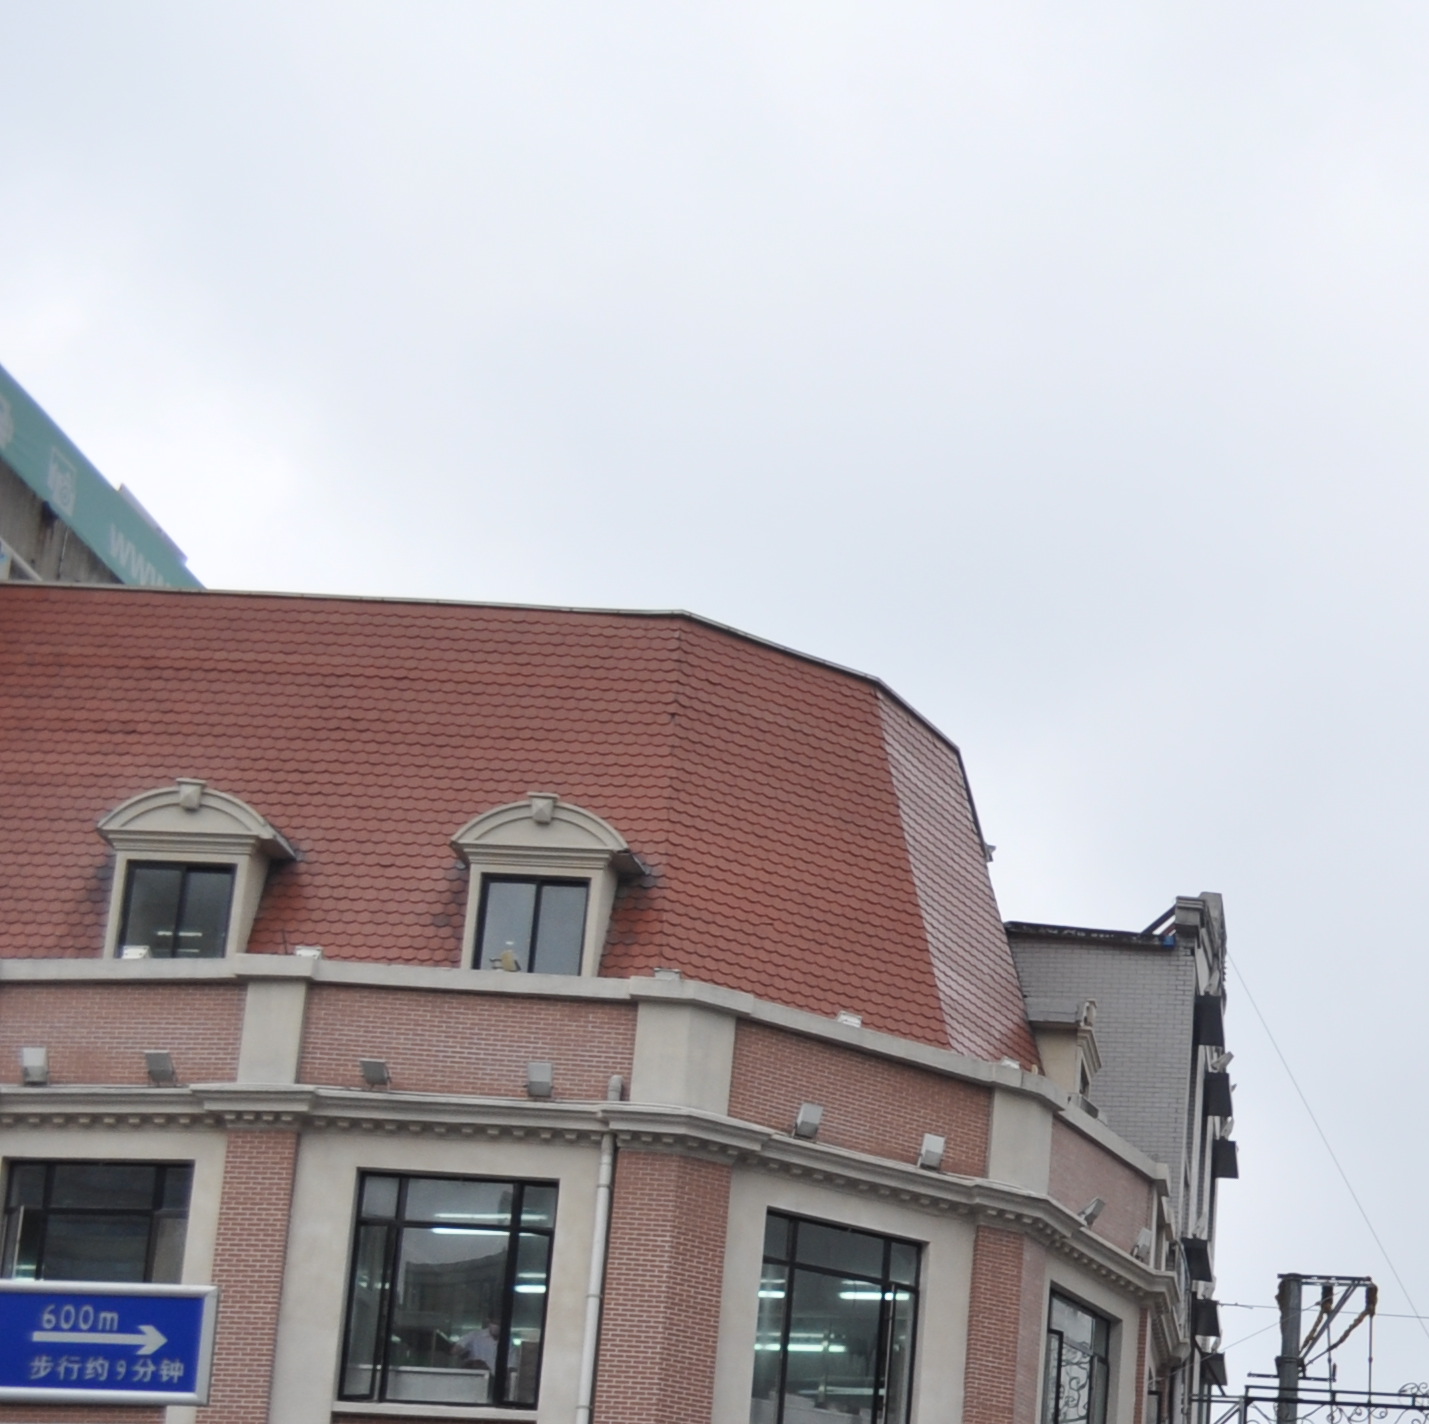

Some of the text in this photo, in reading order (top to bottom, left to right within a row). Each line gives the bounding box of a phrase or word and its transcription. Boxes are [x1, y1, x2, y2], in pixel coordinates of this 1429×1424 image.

[41, 1304, 119, 1331] 600m
[29, 1354, 185, 1384] 步行约9分钟
